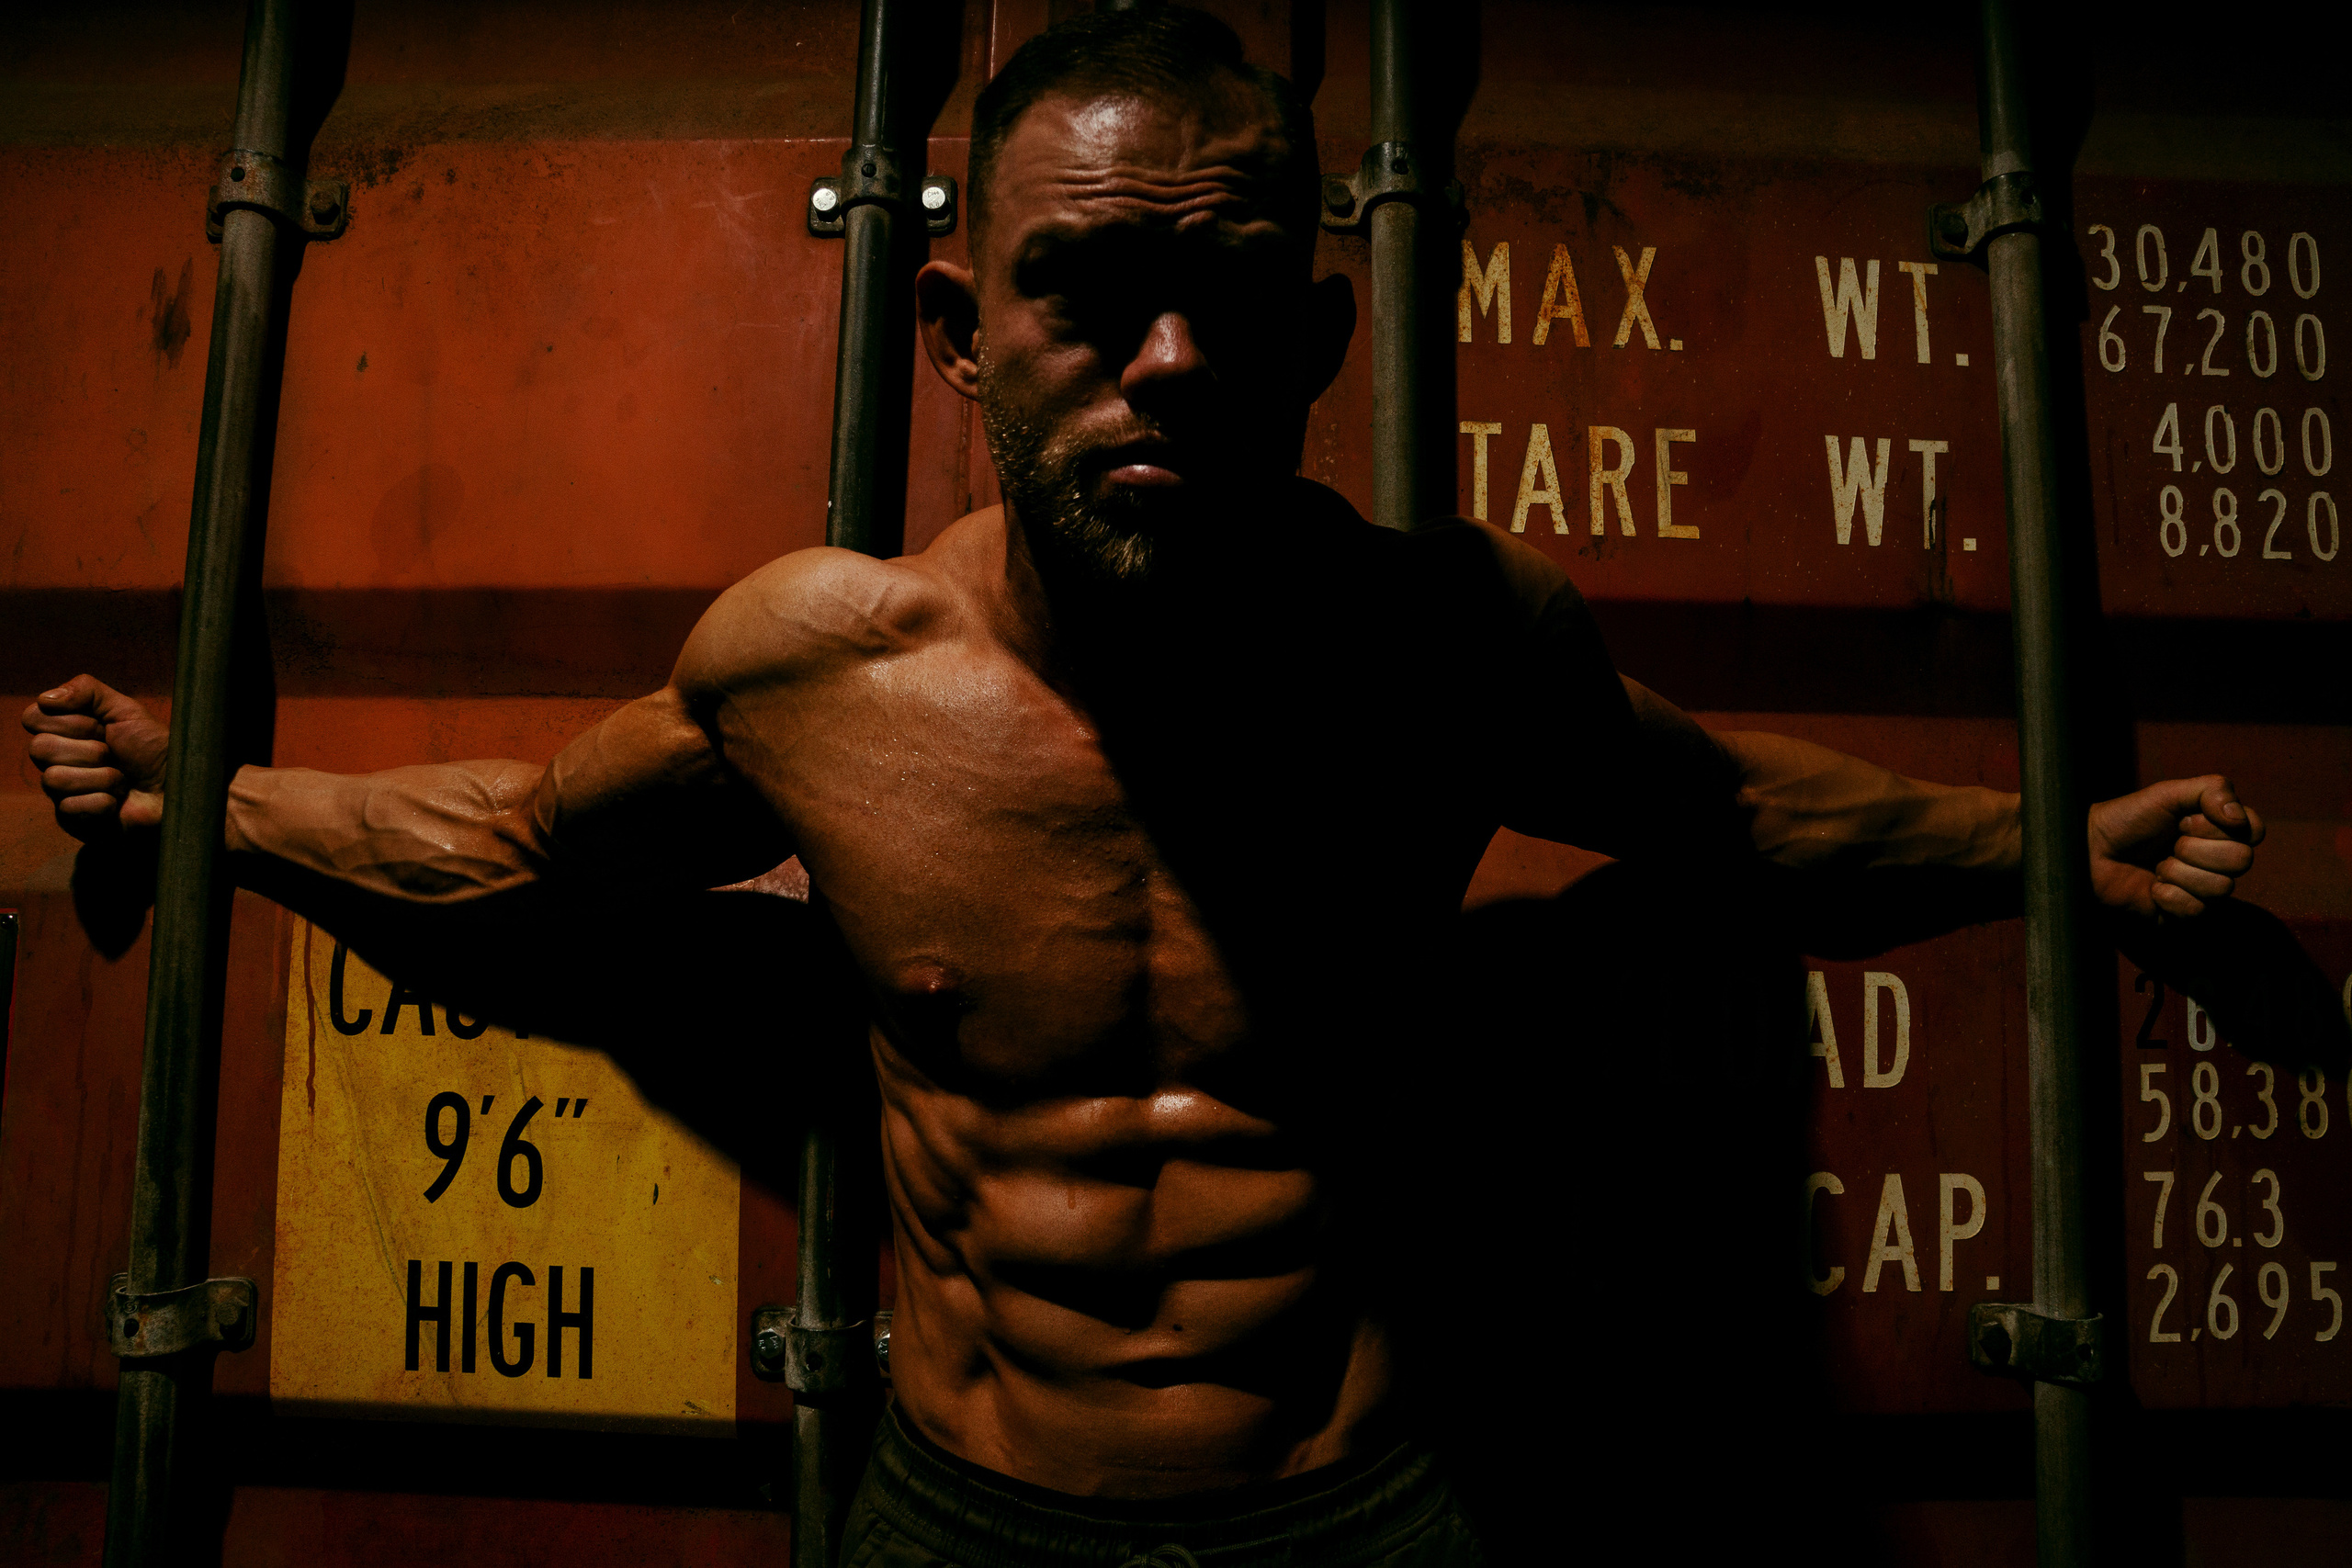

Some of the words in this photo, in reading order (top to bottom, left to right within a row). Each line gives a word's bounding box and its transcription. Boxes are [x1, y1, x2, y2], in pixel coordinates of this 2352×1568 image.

[2087, 223, 2321, 299] 30,480
[1458, 239, 1683, 351] MAX.
[1815, 254, 1969, 367] WT.
[2098, 304, 2326, 381] 67,200
[2152, 401, 2334, 477] 4,000
[1459, 421, 1701, 540] TARE
[1825, 434, 1977, 551] WT.
[2159, 484, 2340, 562] 8,820
[2140, 1060, 2352, 1143] 58,38
[1798, 1171, 2001, 1297] CAP.
[2143, 1167, 2285, 1249] 76.3
[404, 1259, 594, 1380] HIGH
[2146, 1260, 2345, 1344] 2,695
